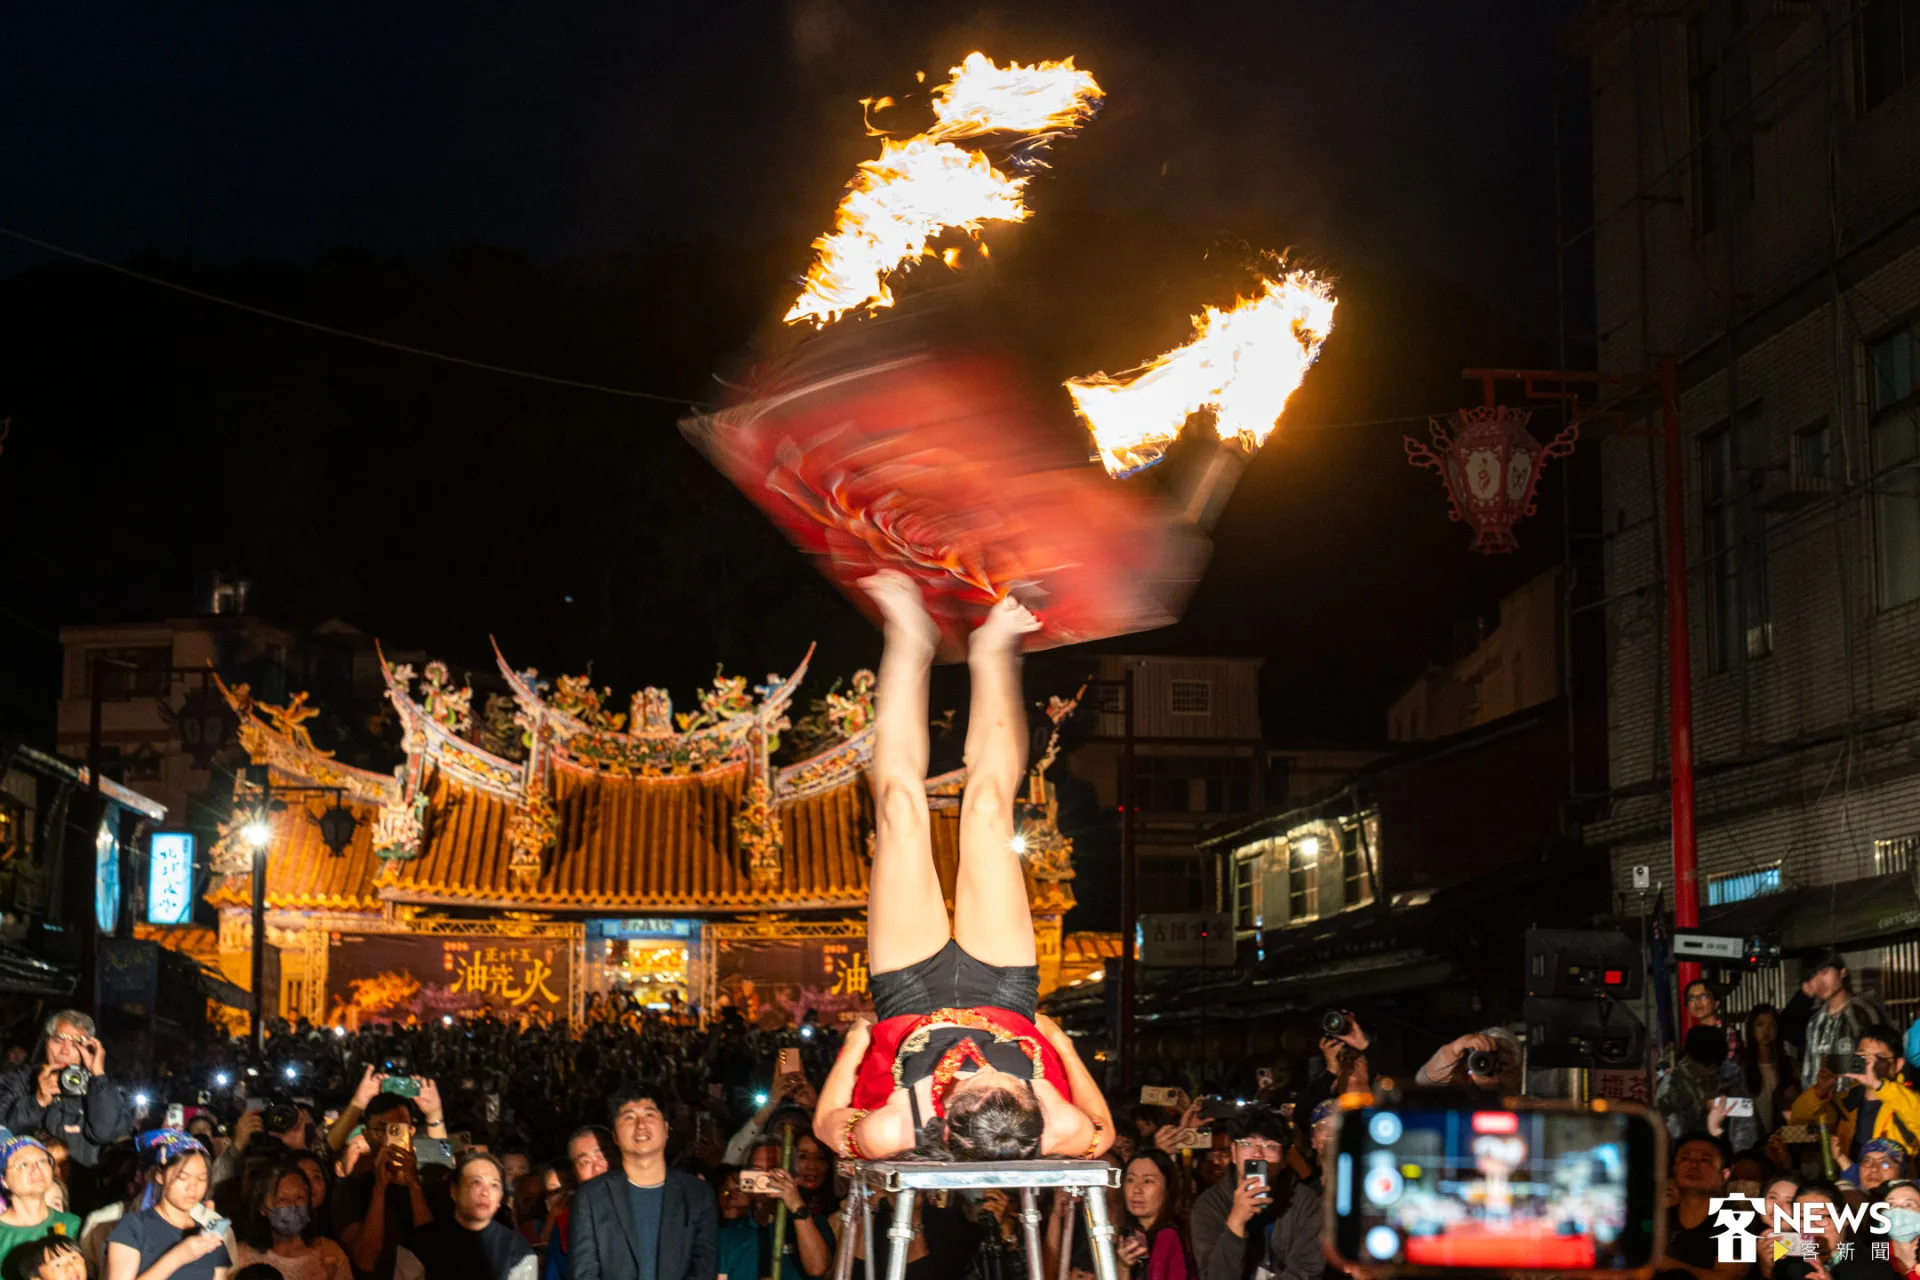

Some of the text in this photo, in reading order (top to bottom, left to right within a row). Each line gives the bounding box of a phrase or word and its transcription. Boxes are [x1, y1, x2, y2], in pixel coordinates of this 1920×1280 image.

[484, 947, 532, 962] 正月十五
[830, 951, 871, 997] 油
